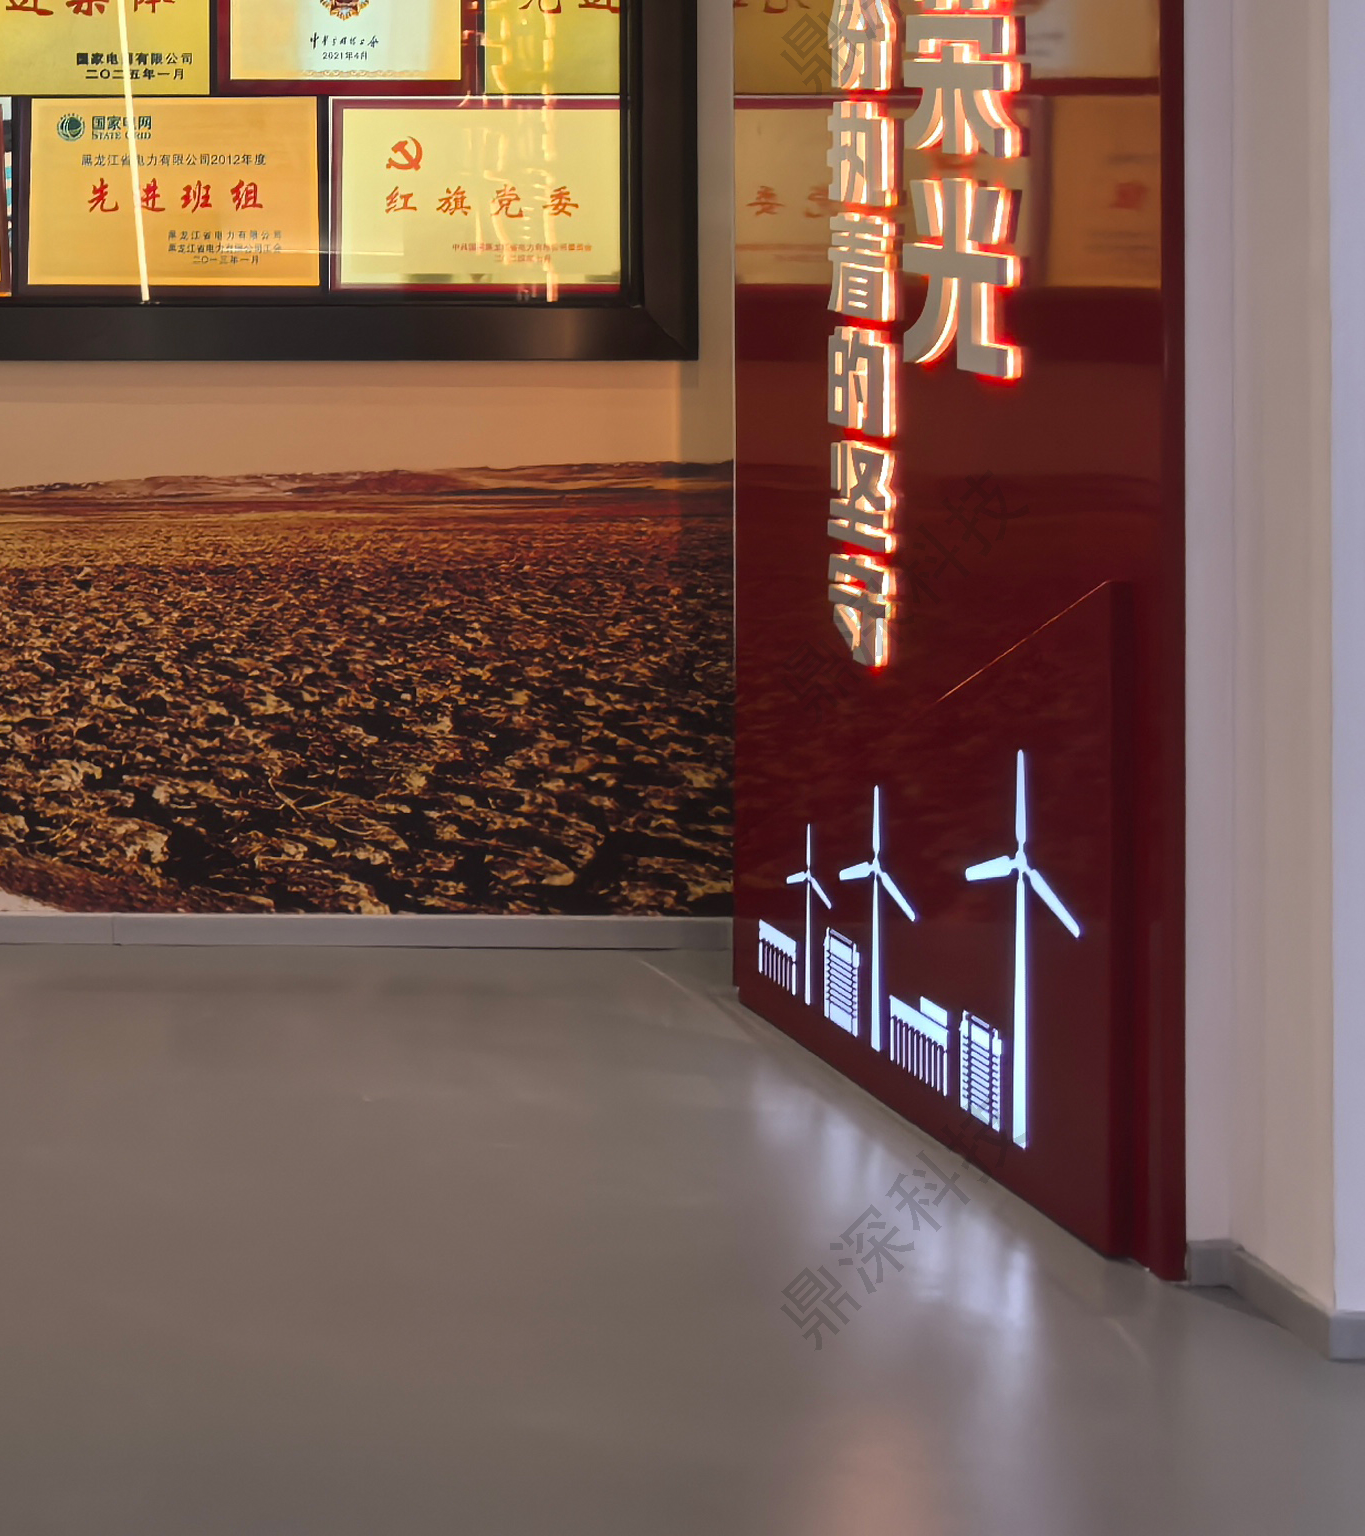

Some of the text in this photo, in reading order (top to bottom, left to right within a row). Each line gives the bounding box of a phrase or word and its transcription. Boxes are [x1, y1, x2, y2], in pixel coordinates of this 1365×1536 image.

[87, 177, 263, 214] 先进班组
[385, 184, 580, 219] 红旗党委
